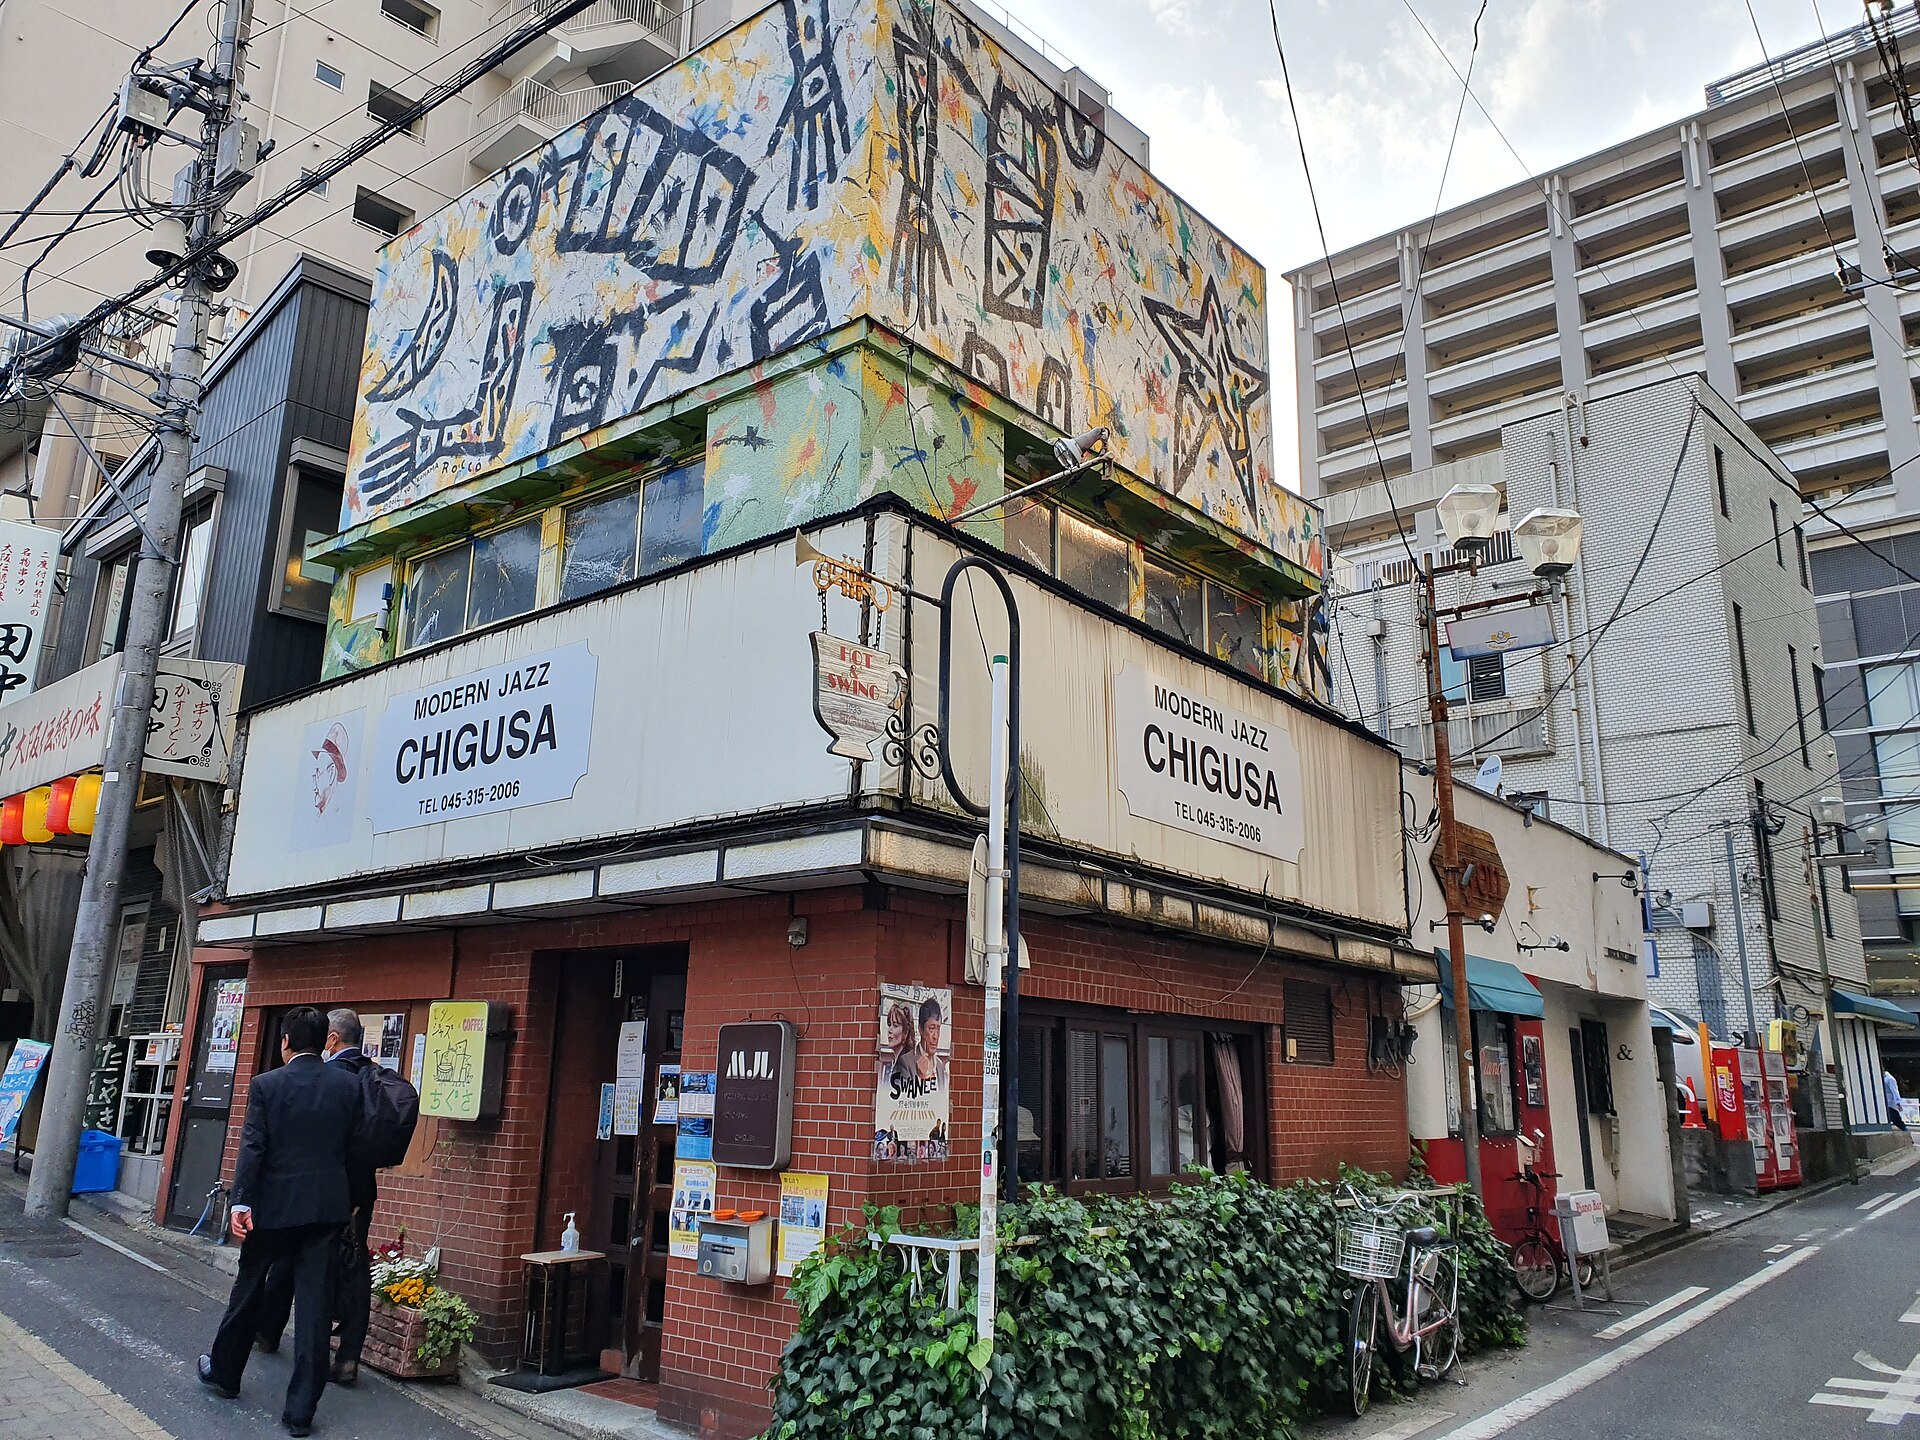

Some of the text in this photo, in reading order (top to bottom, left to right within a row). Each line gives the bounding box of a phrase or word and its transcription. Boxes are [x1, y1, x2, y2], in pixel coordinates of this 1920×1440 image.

[15, 547, 32, 596] 名物串カツ
[839, 646, 873, 669] HOT
[849, 664, 860, 679] &
[413, 661, 551, 722] MODERN JAZZ
[826, 673, 880, 701] SWING
[9, 690, 103, 771] 大阪伝統の味
[163, 682, 190, 756] かすうどん
[190, 701, 210, 743] 串カツ
[1153, 684, 1270, 753] MODERN JAZZ
[395, 703, 558, 785] CHIGUSA
[1142, 723, 1284, 815] CHIGUSA
[418, 779, 521, 816] TEL 045-315-2006
[1174, 800, 1262, 843] TEL 045-315-2006
[462, 1018, 484, 1032] COFFEE
[1617, 1044, 1634, 1061] &
[96, 1041, 123, 1132] たこやき
[430, 1089, 473, 1112] ちぐさ
[889, 1071, 937, 1101] SWANEE
